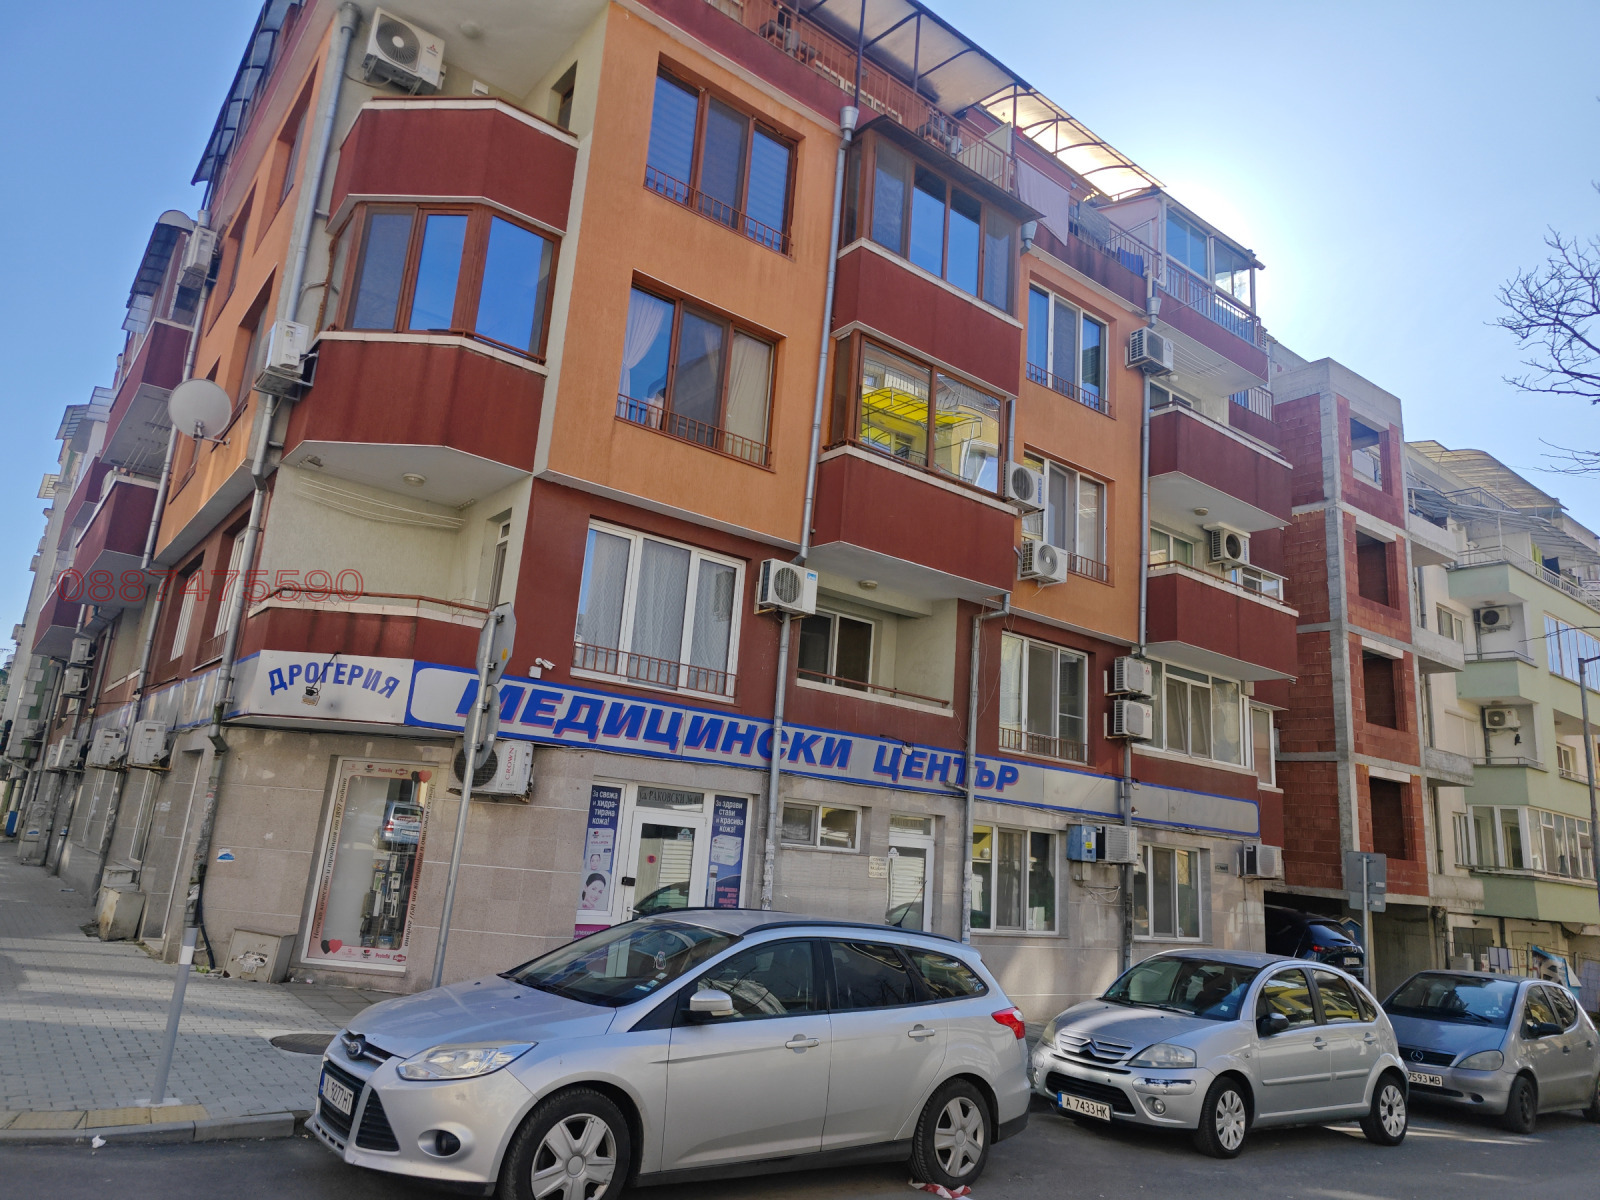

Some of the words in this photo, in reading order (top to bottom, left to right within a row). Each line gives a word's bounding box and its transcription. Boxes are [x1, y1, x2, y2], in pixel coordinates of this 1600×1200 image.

[268, 661, 400, 699] ДРОГЕРИЯ
[455, 679, 852, 770] МЕДИЦИНСКИ
[873, 744, 1019, 792] ЦЕНТЪР
[505, 747, 515, 780] CROWN
[592, 790, 598, 798] За
[599, 790, 618, 799] свежа
[648, 790, 685, 804] РАКОВСКИ
[722, 801, 743, 809] здрави
[594, 808, 616, 817] тирана
[718, 809, 736, 817] стави
[592, 817, 610, 826] кожа!
[720, 818, 744, 826] красива
[719, 826, 737, 834] кожа!
